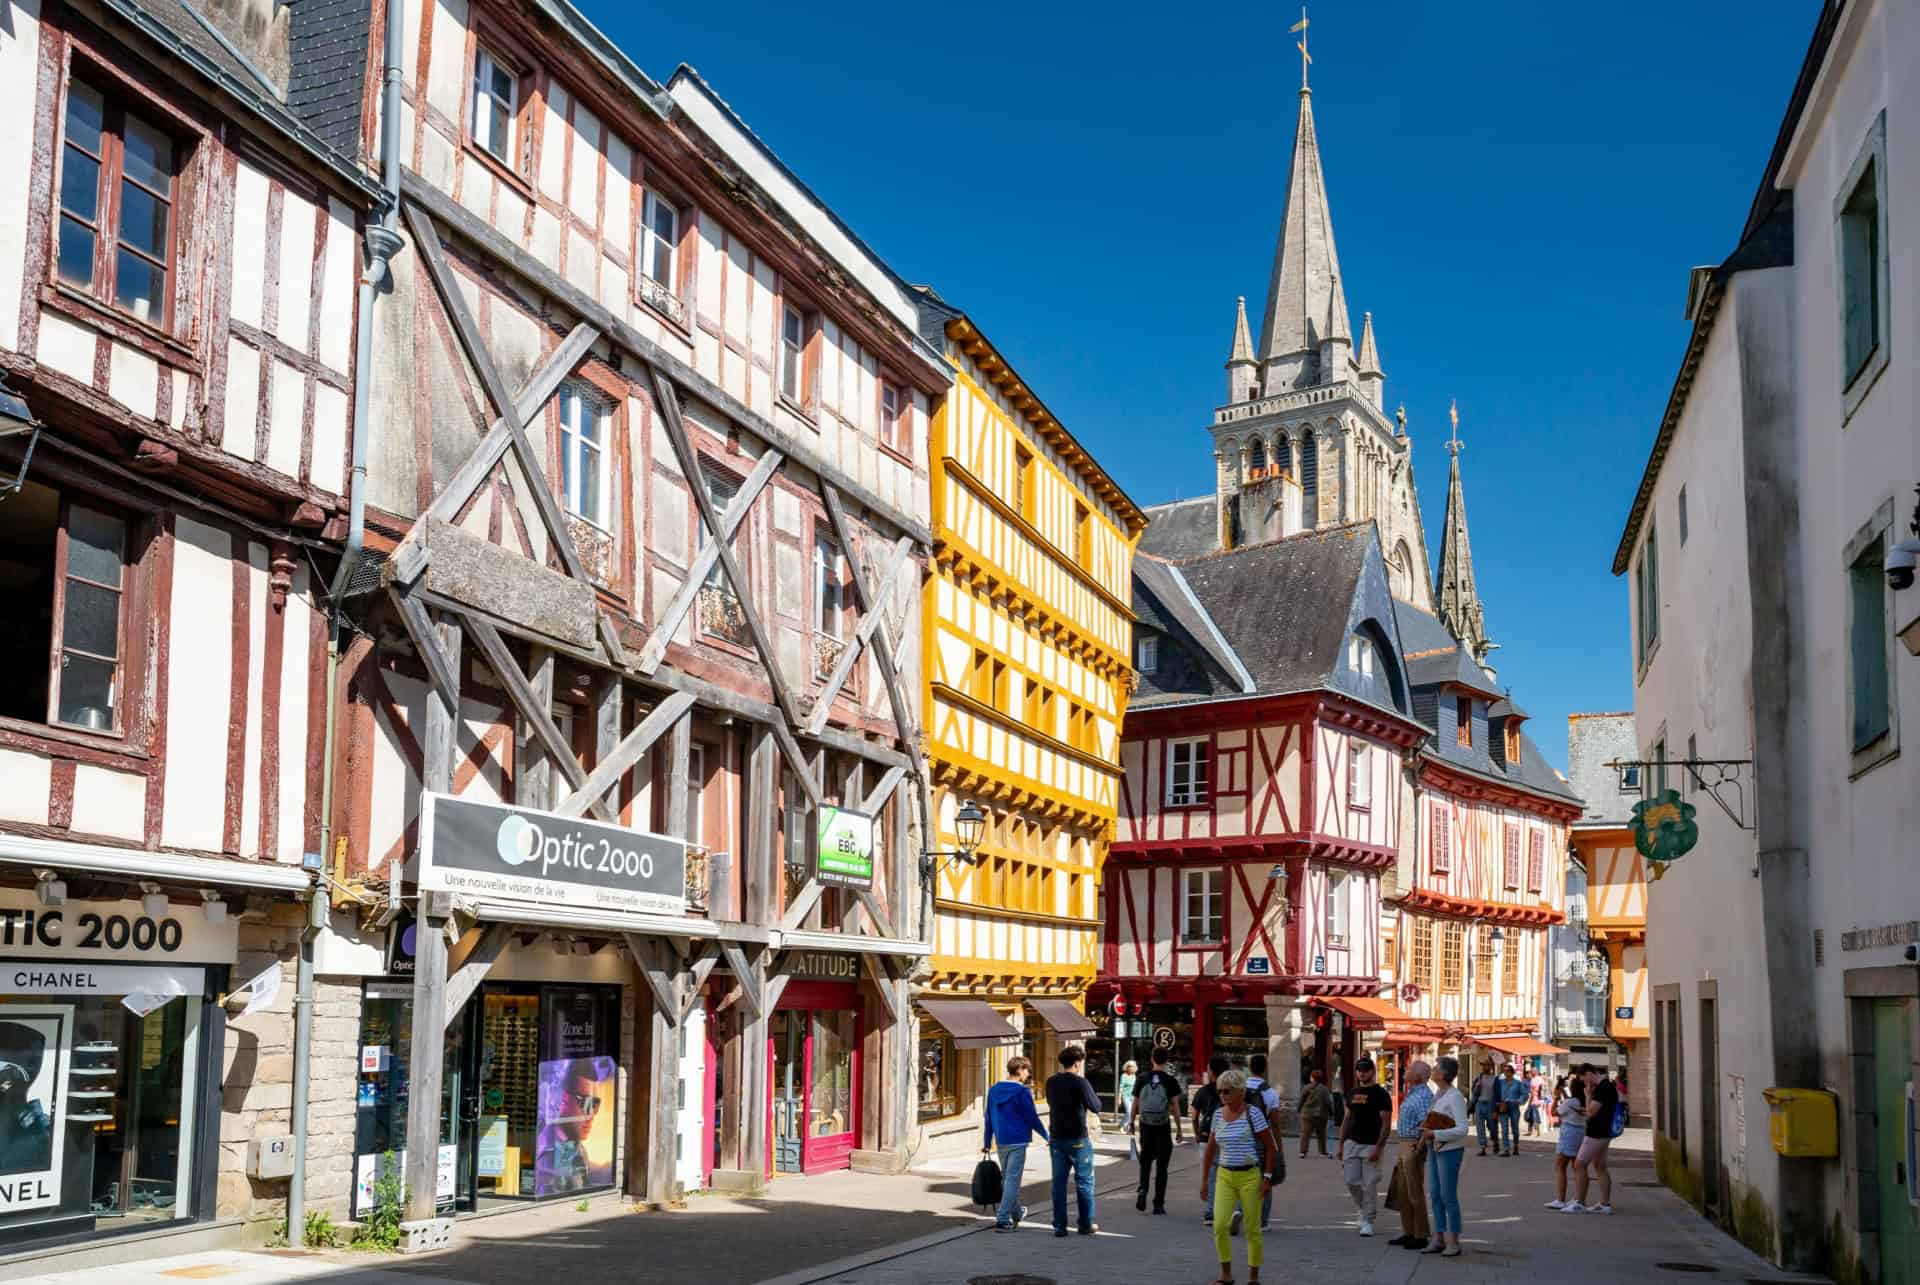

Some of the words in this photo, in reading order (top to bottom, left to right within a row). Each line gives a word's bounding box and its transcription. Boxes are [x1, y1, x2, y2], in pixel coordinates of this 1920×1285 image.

[517, 823, 595, 876] Optic
[598, 839, 654, 879] 2000
[838, 838, 857, 855] EBC
[444, 873, 465, 887] Une
[467, 877, 507, 893] nouvelle
[509, 884, 533, 895] vision
[534, 885, 545, 896] de
[77, 913, 183, 951] 2000
[792, 951, 857, 977] ATITUDE
[14, 972, 97, 988] CHANEL
